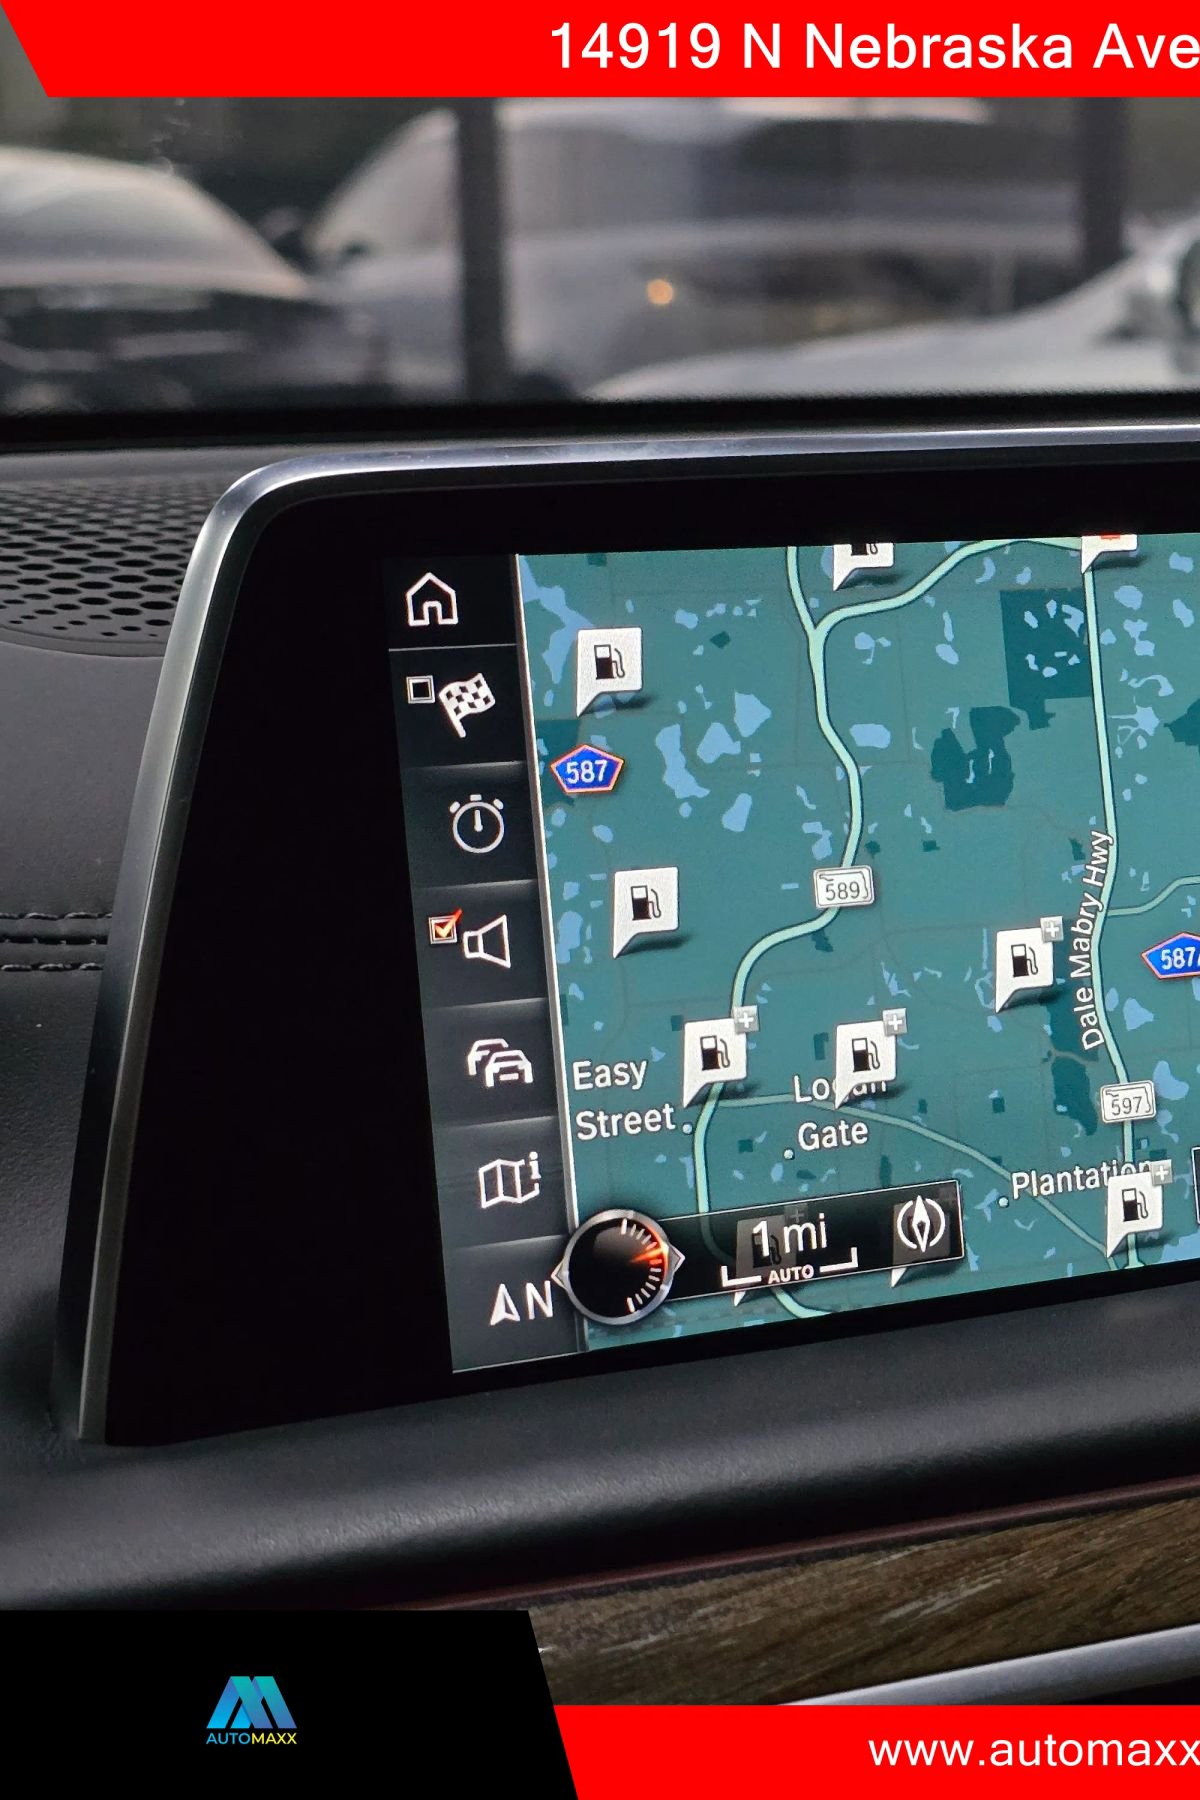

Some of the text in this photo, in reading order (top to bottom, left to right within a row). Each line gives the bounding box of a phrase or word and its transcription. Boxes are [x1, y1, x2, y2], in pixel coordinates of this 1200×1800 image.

[566, 759, 608, 784] 587
[825, 880, 861, 901] 589
[1069, 830, 1115, 1051] Dale Mabry Hwy
[572, 1059, 648, 1091] Easy
[575, 1102, 676, 1141] Street
[1111, 1096, 1143, 1116] 597
[798, 1119, 869, 1151] Gate
[750, 1211, 829, 1258] 1 mi
[767, 1263, 815, 1285] AUTO
[526, 1279, 554, 1320] N
